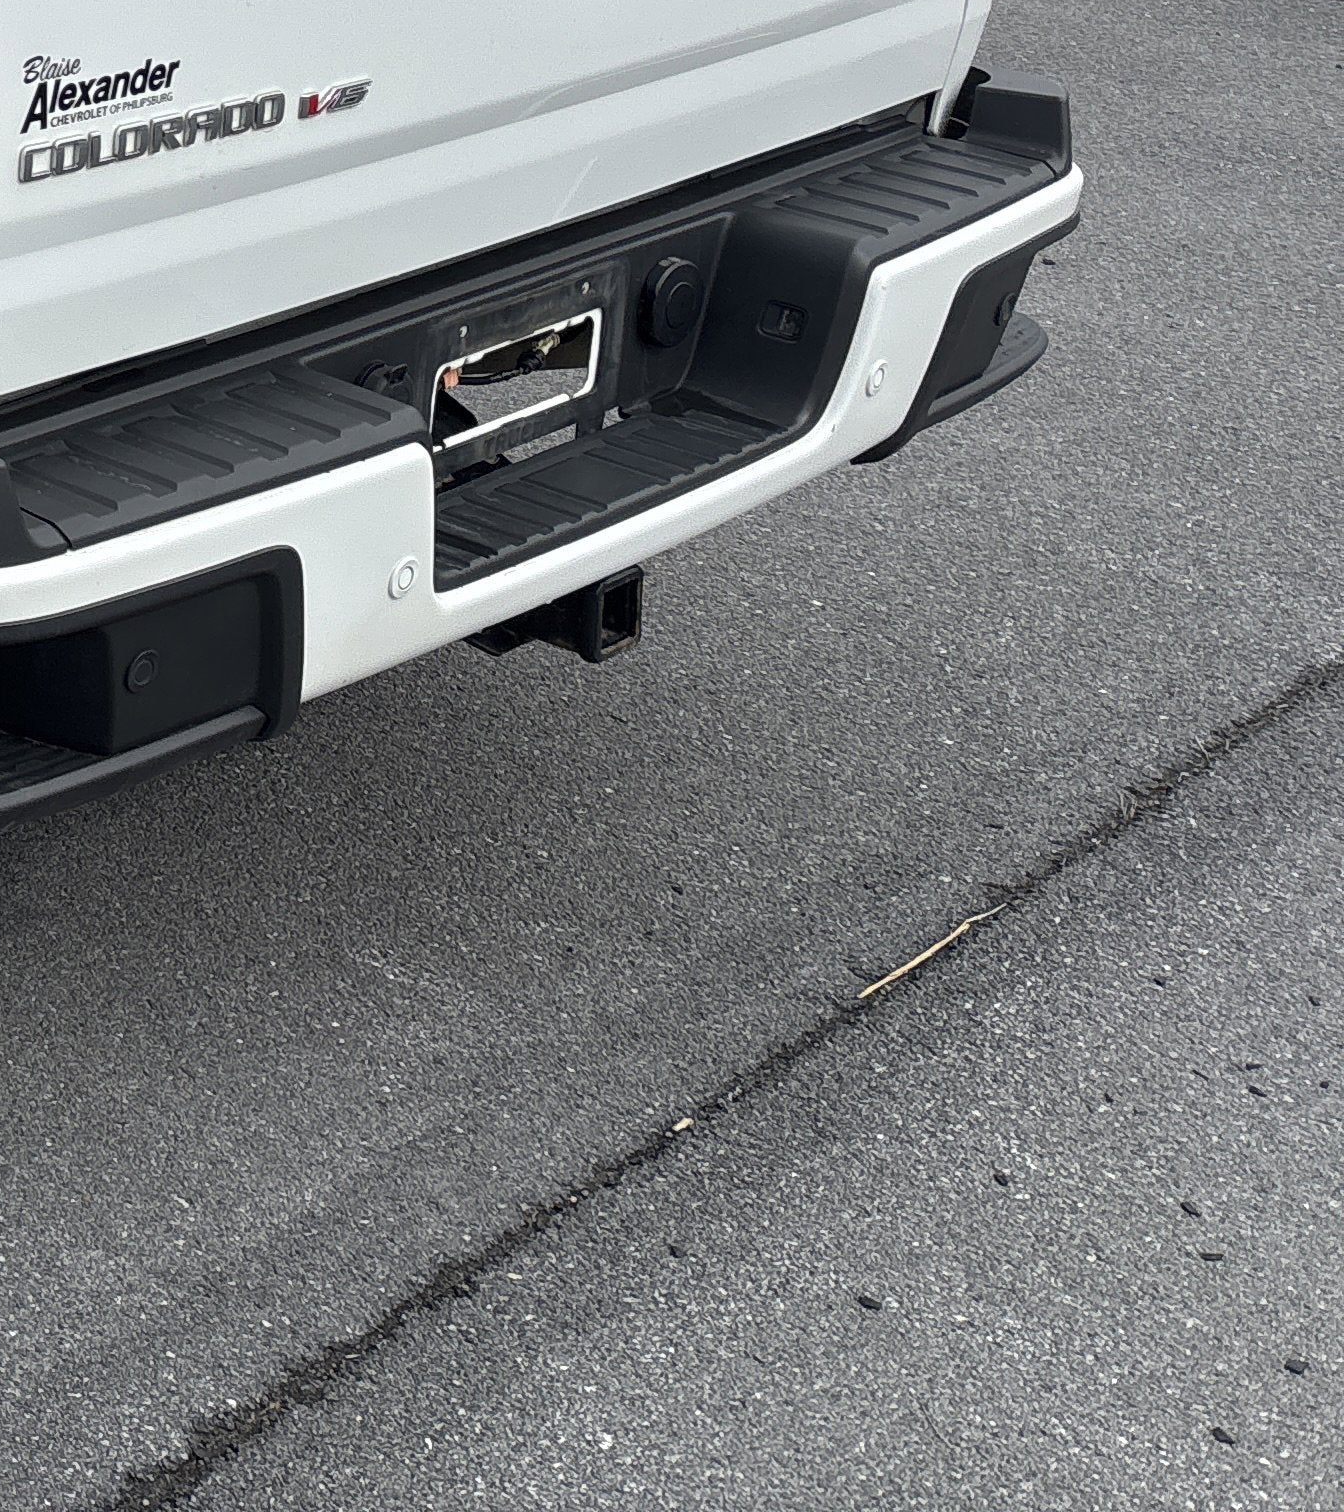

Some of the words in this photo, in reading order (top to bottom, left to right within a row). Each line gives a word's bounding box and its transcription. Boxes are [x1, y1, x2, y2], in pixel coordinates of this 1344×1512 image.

[23, 55, 81, 84] Blaise
[20, 58, 181, 135] Alexander
[50, 105, 109, 128] CHEVROLET
[109, 102, 122, 115] OF
[18, 89, 286, 184] COLORADO
[297, 78, 373, 120] V6
